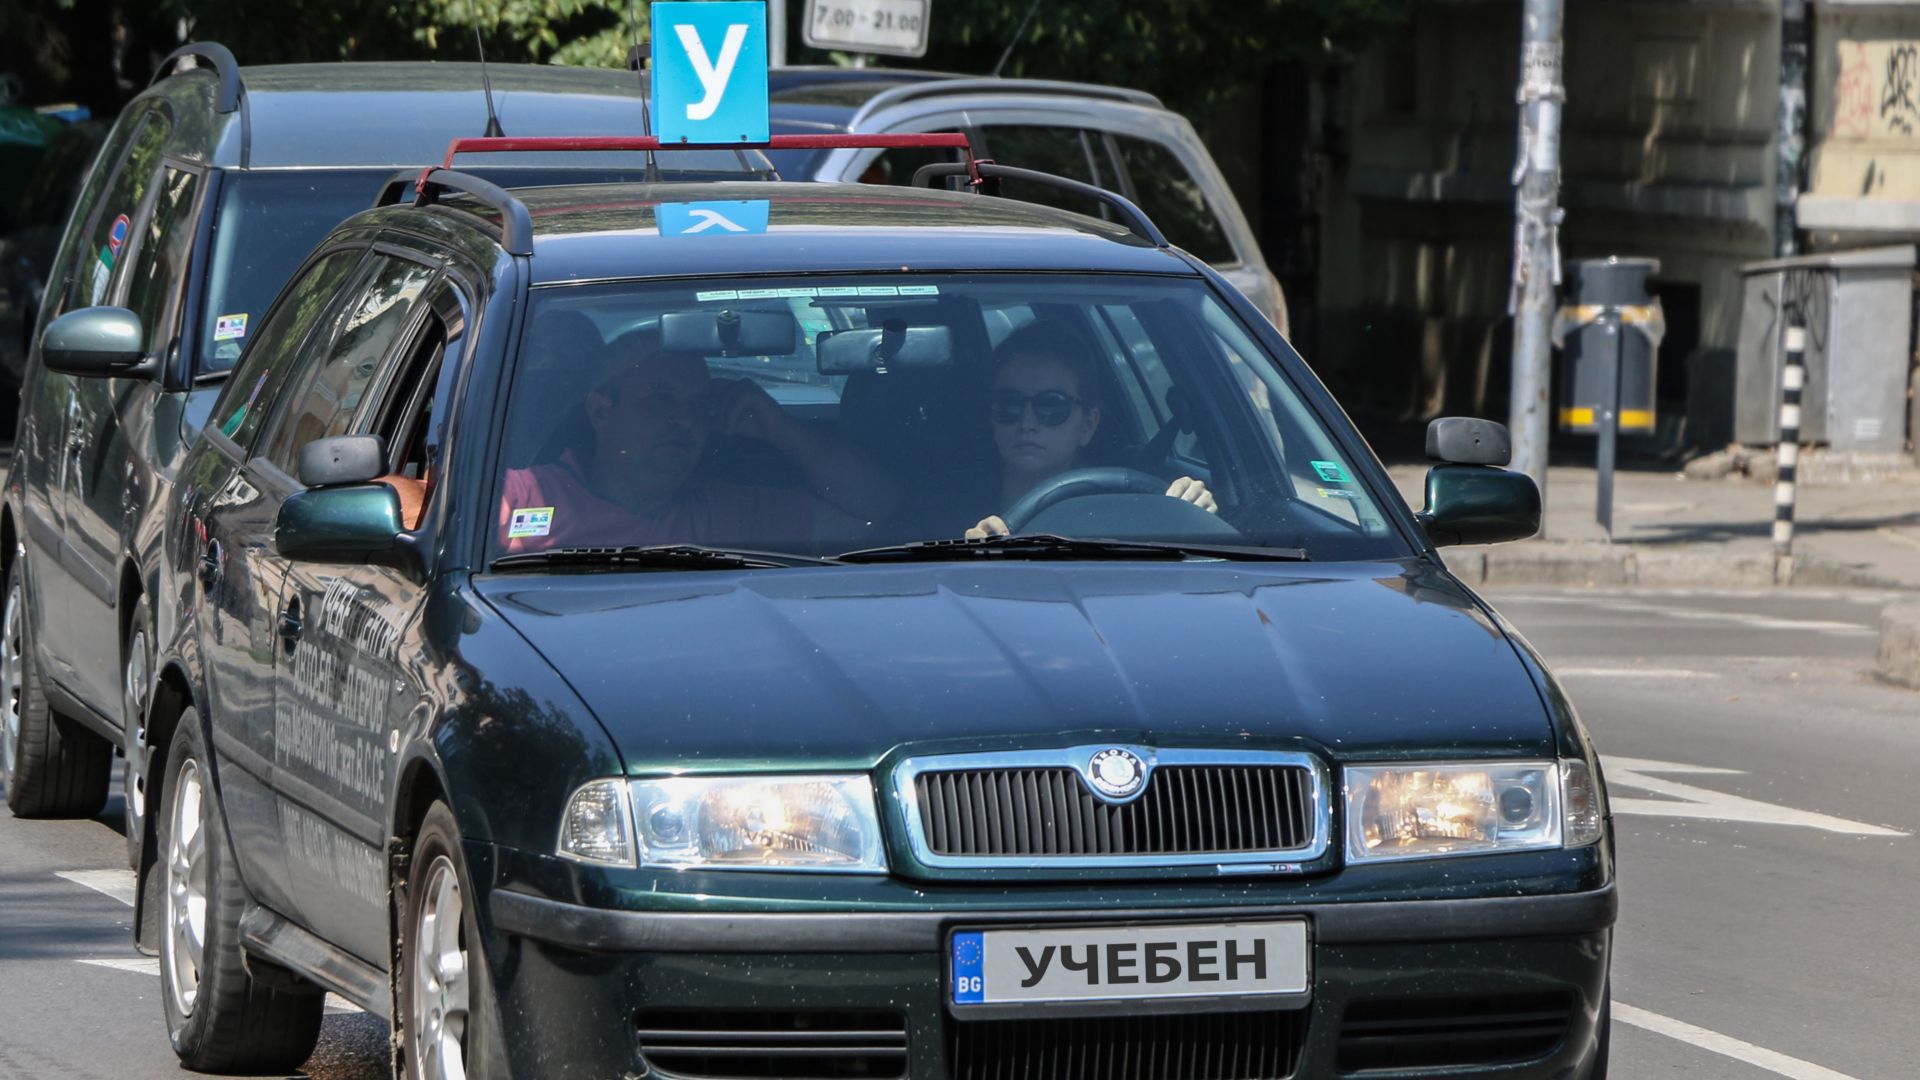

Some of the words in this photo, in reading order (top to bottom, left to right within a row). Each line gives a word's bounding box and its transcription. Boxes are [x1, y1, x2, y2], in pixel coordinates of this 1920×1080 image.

[673, 24, 749, 120] У
[958, 976, 981, 993] BG
[1015, 938, 1267, 987] УЧЕБЕН
